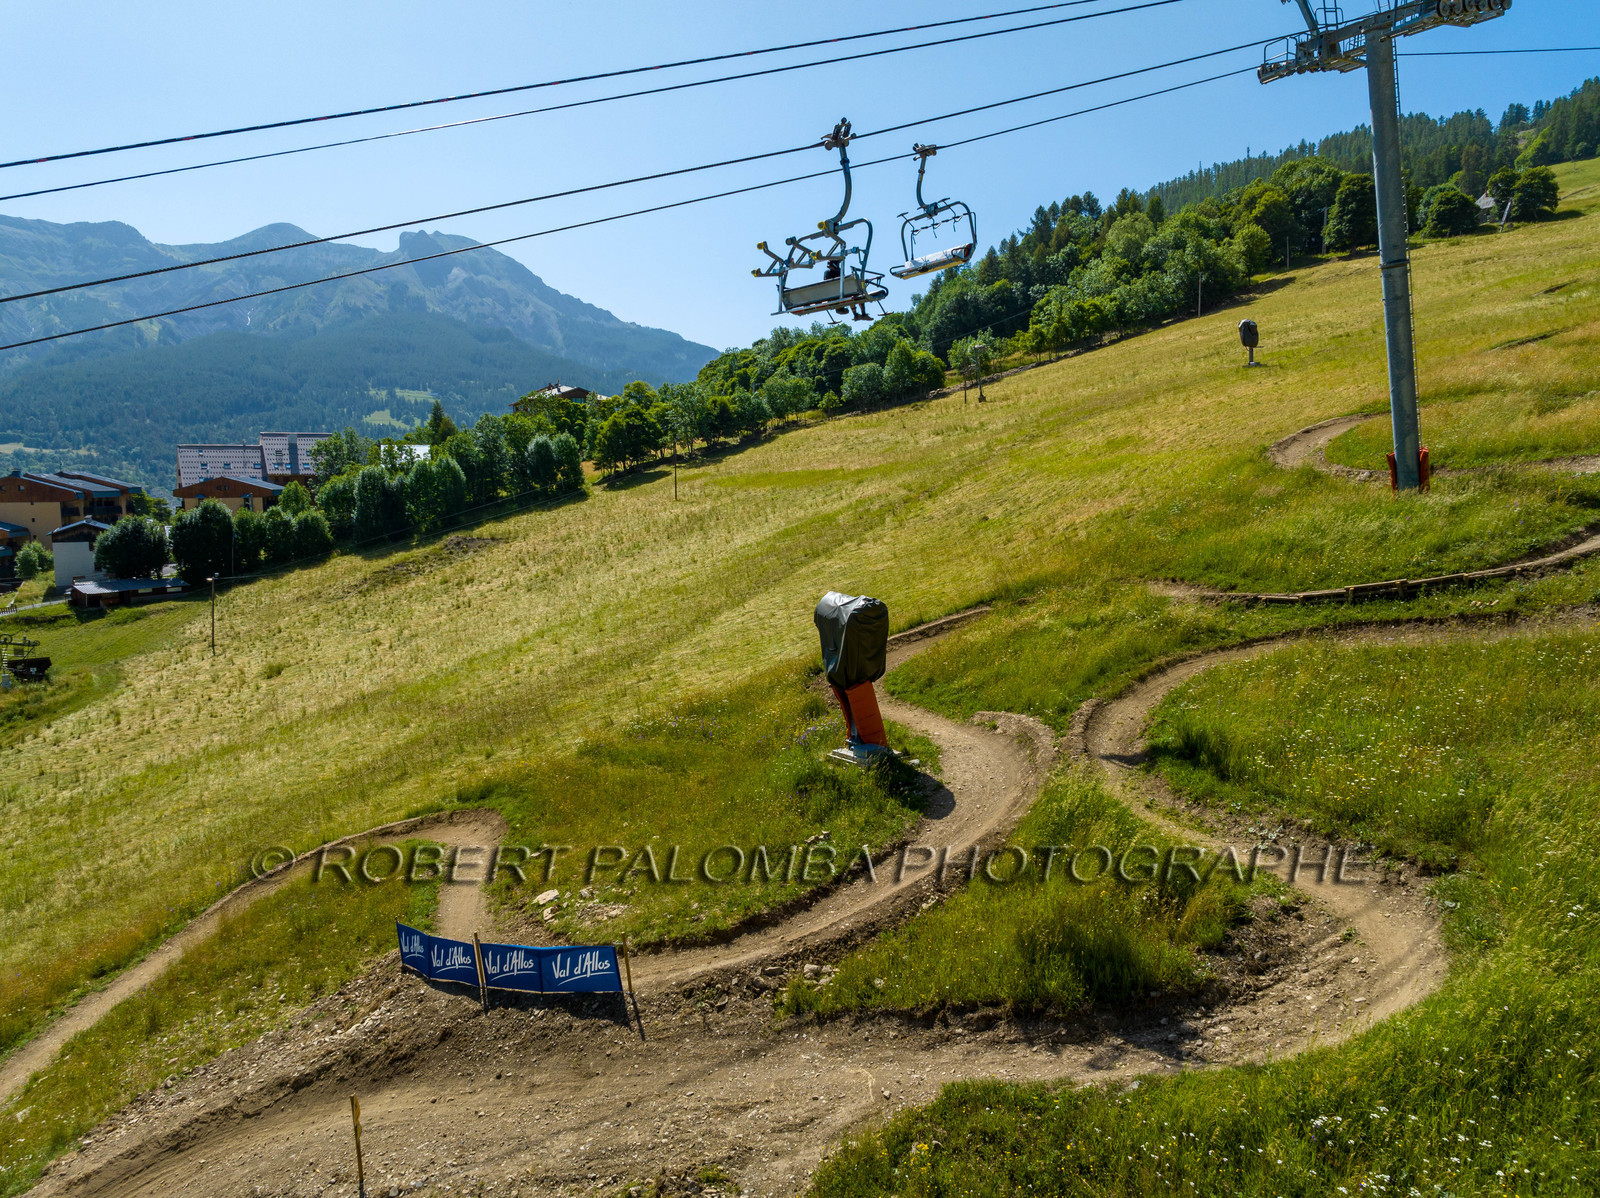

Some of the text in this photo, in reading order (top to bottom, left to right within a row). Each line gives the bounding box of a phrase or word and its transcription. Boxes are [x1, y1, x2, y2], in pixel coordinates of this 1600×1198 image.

[431, 945, 472, 970] Val d'Allos
[484, 949, 535, 976] Val d'Allos
[552, 951, 611, 979] Val d'Allos
